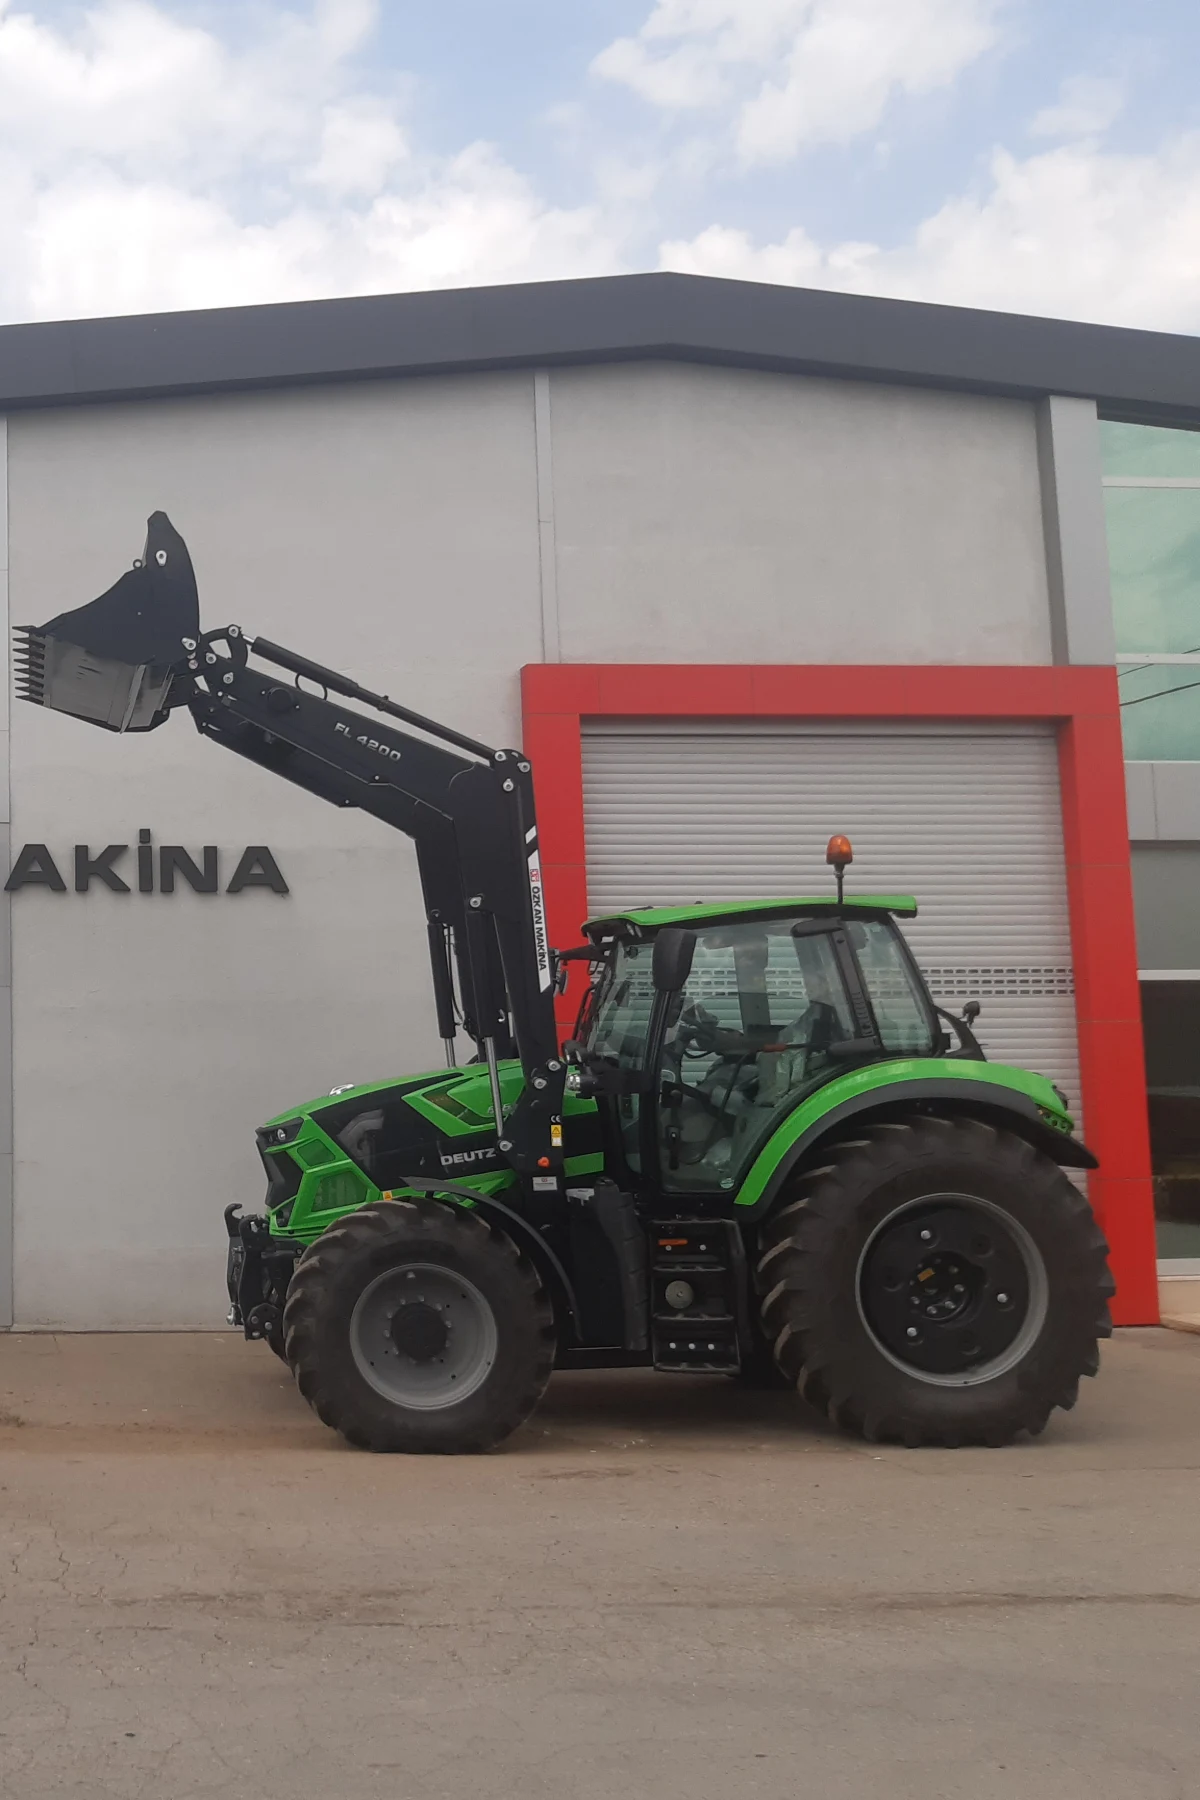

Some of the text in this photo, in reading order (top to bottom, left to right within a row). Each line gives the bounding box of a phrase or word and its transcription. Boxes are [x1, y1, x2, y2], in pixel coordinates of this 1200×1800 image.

[334, 722, 402, 761] FL 4200
[531, 886, 543, 925] ÖZKAN
[535, 927, 547, 971] MAKİNA
[440, 1148, 496, 1166] DEUTZ
